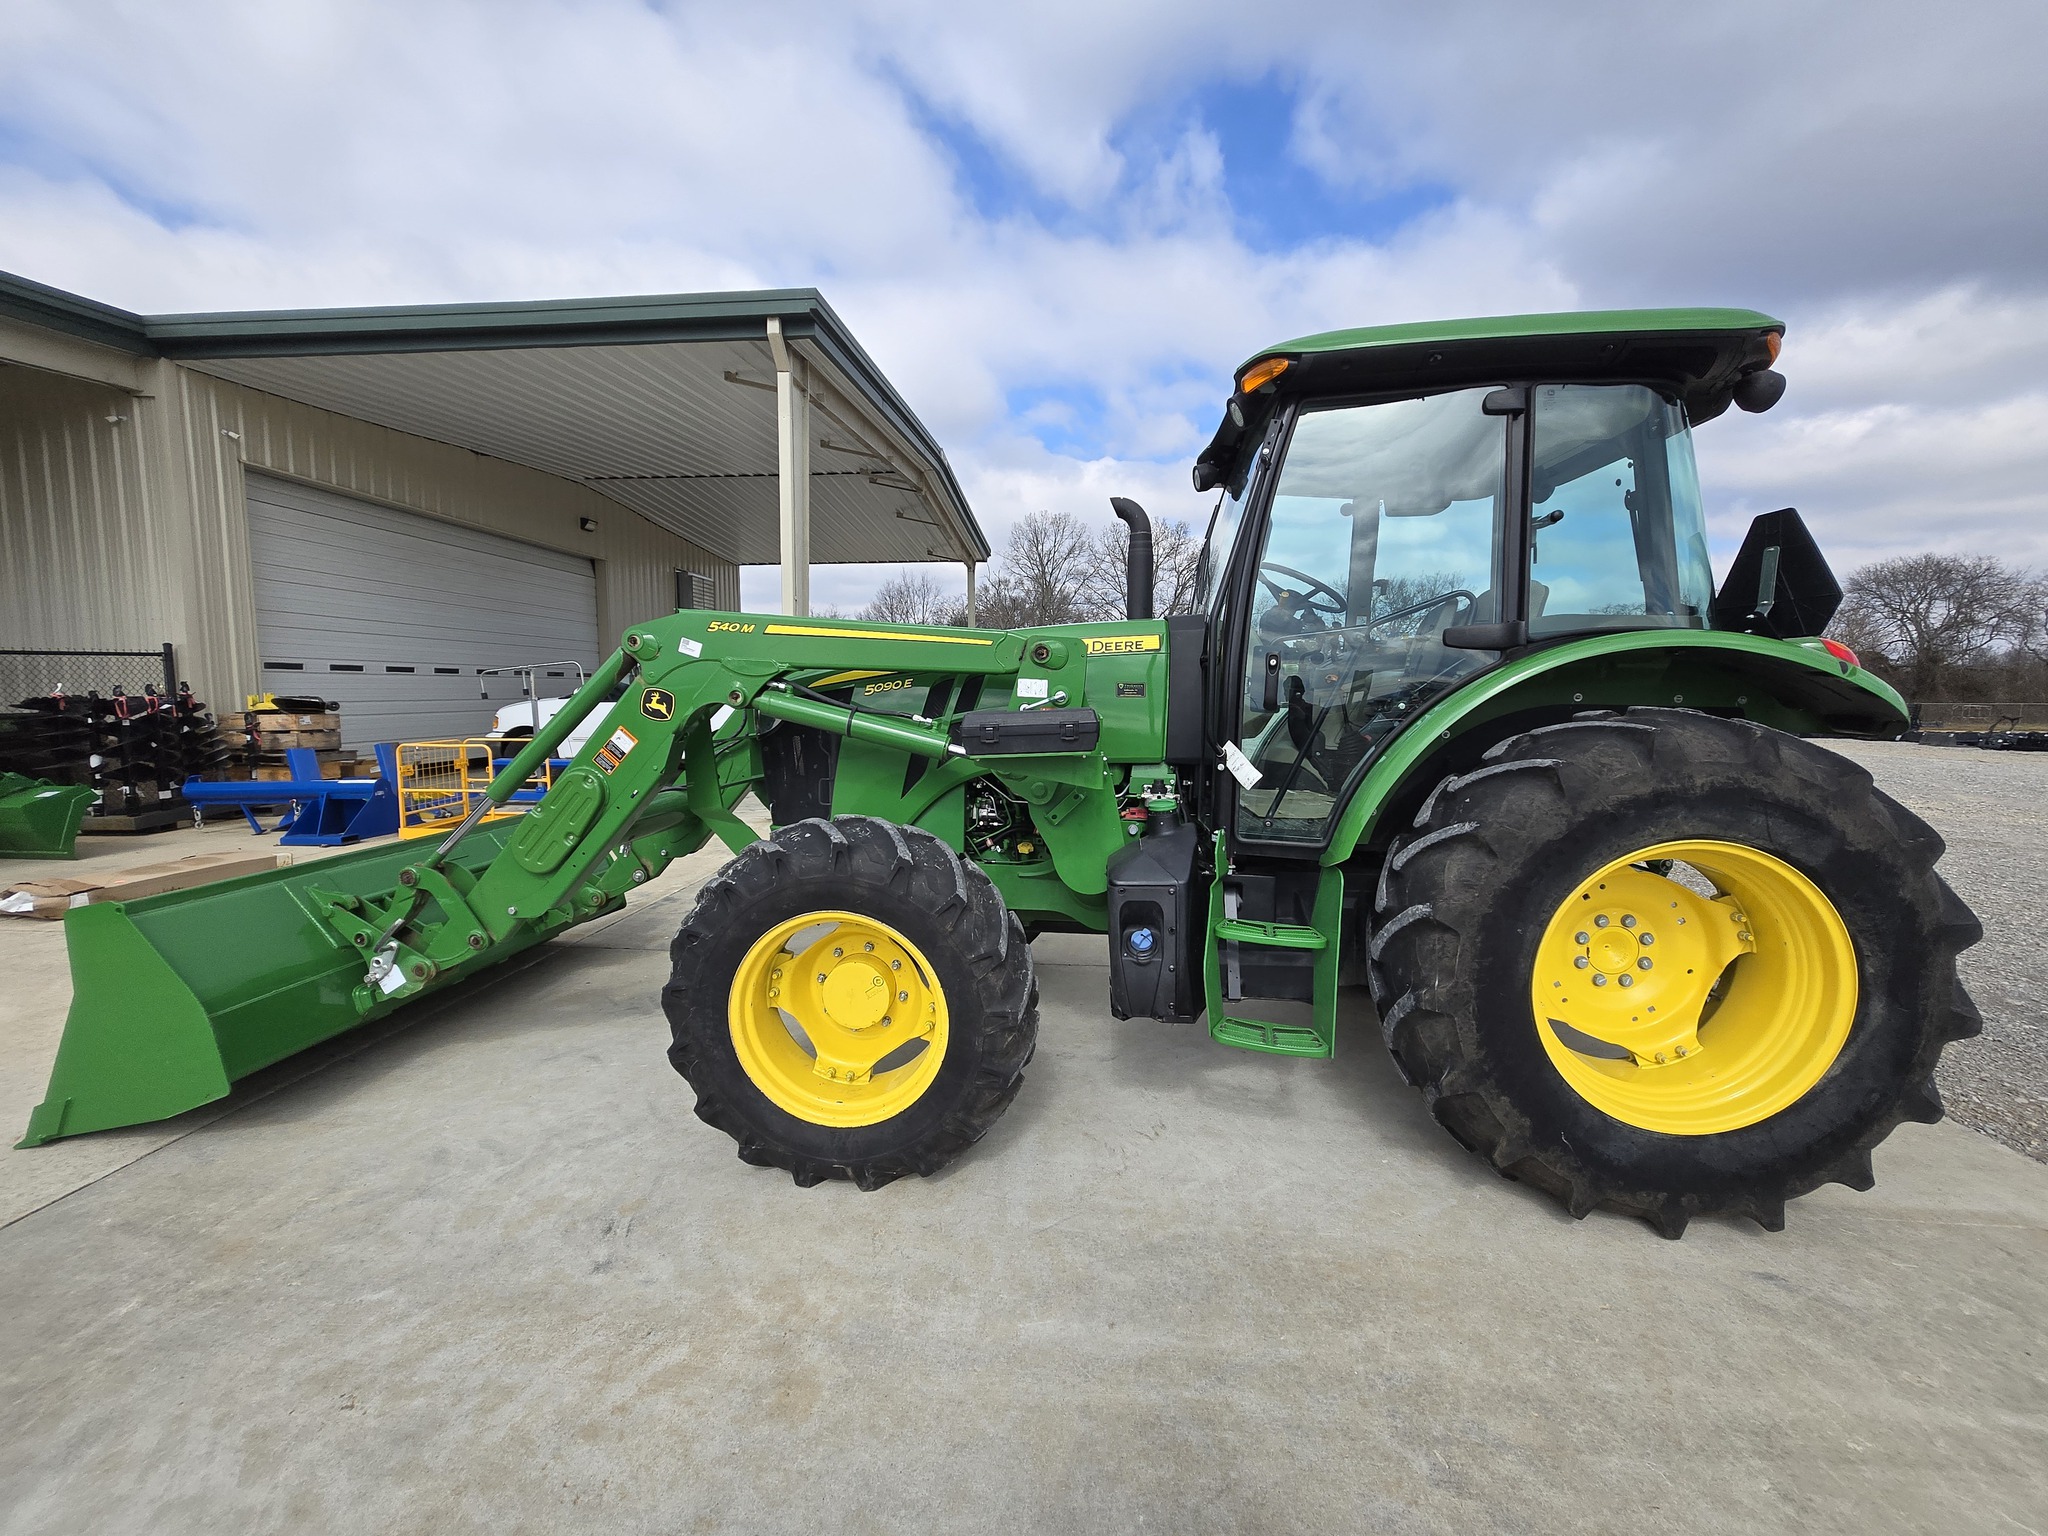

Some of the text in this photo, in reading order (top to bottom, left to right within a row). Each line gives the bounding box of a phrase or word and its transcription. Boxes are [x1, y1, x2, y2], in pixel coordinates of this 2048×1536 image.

[706, 620, 756, 634] 540 M
[1092, 640, 1144, 652] DEERE
[863, 678, 914, 696] 5090 E
